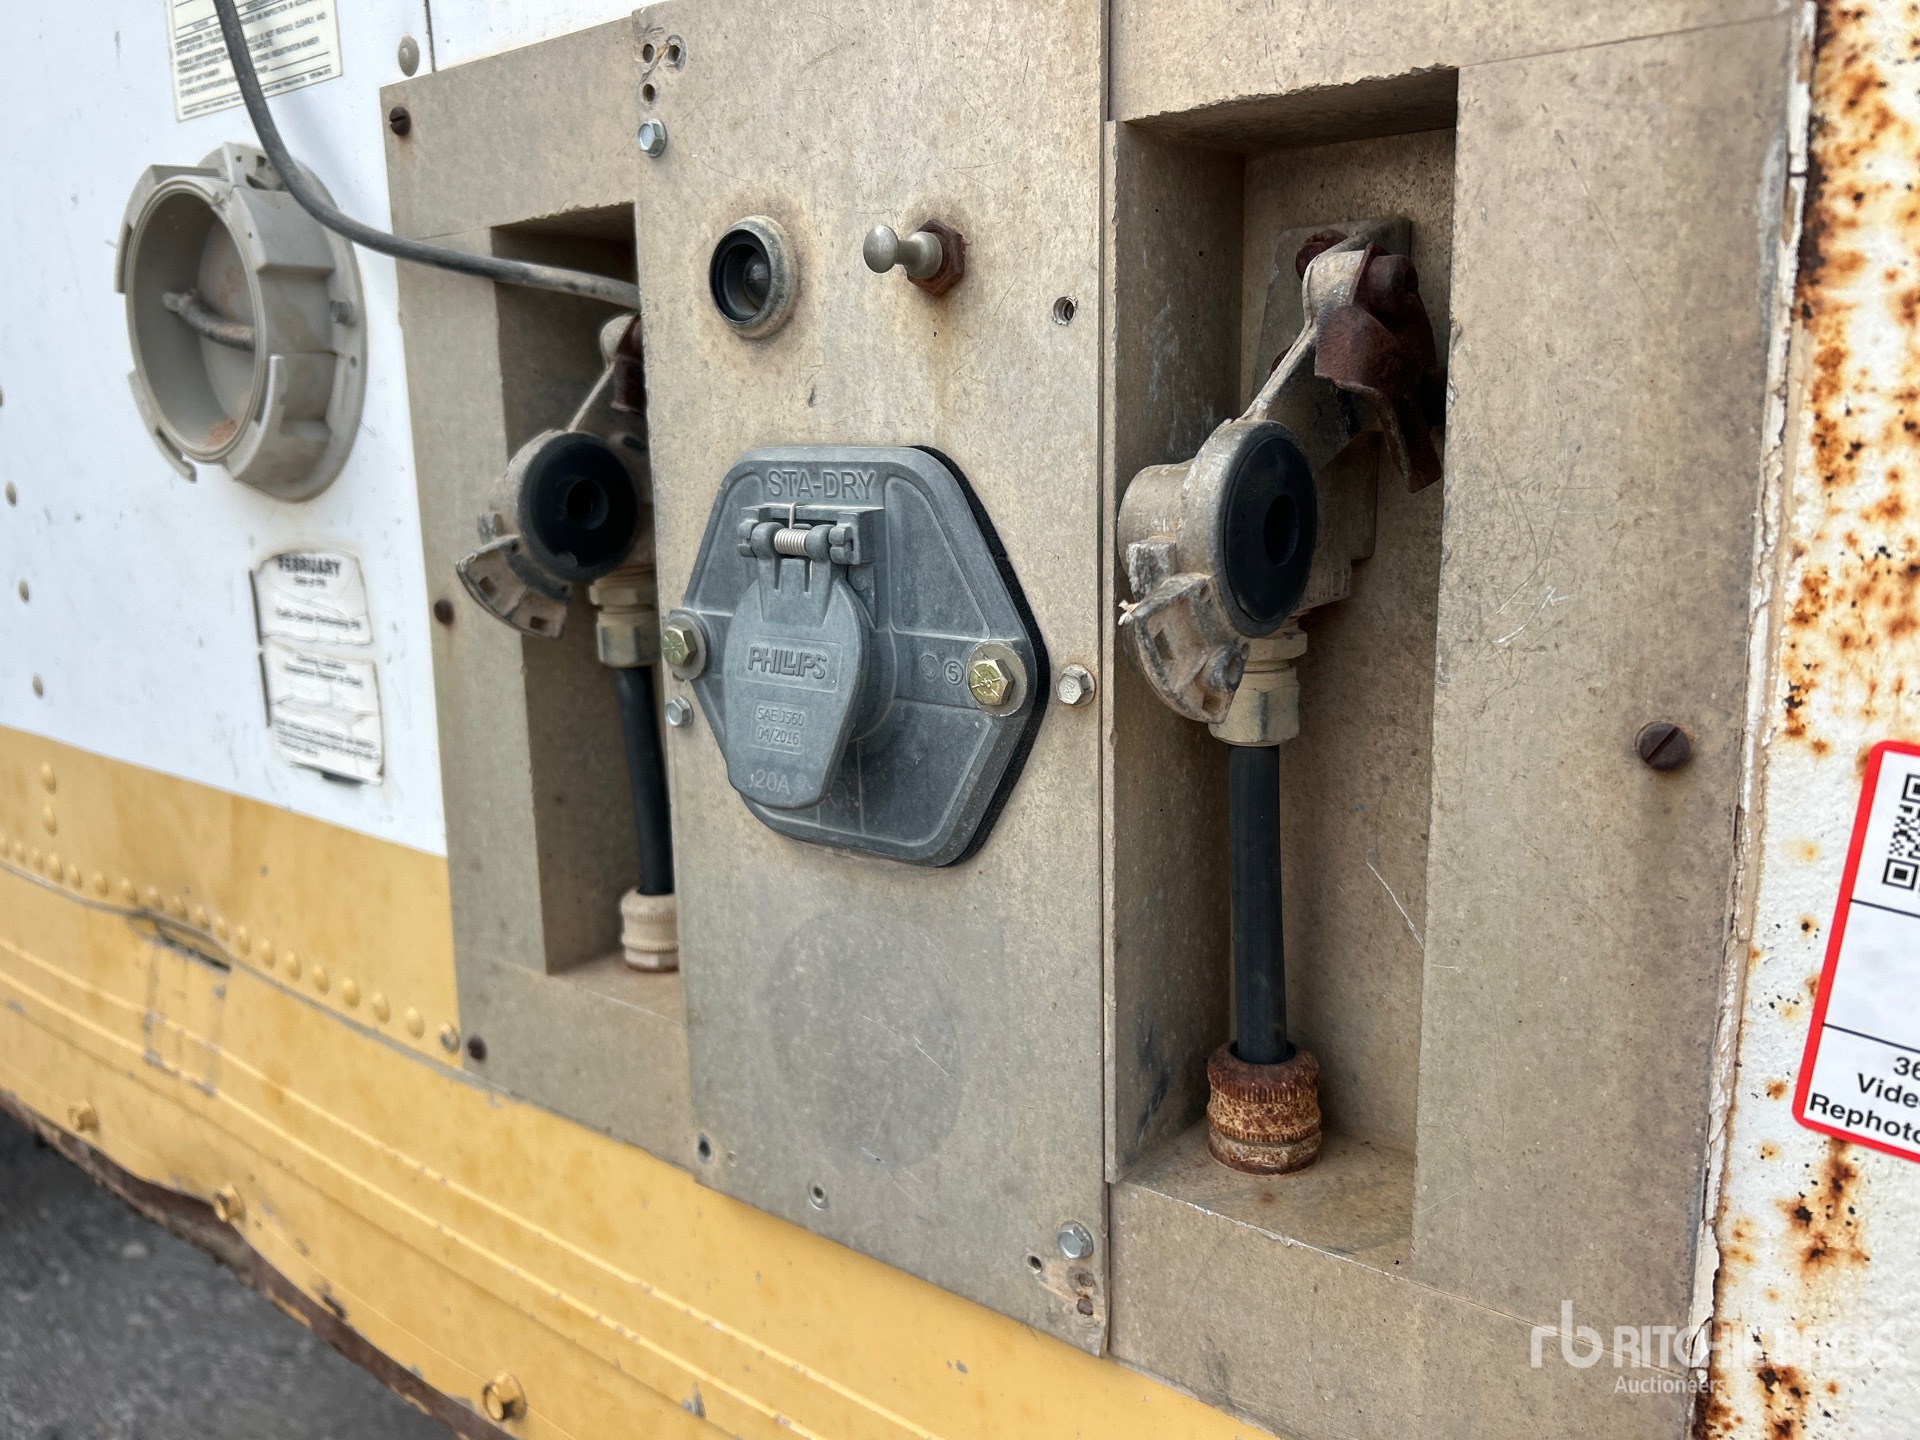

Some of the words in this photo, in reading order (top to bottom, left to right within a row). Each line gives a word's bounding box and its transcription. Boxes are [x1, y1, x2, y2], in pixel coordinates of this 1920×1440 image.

[768, 470, 875, 499] STA-DRY
[748, 646, 827, 679] PHILLIPS
[757, 707, 778, 722] SAE
[780, 710, 804, 726] J560
[757, 726, 800, 745] 04/2016
[756, 768, 791, 795] 20A
[1857, 1072, 1920, 1109] Vide
